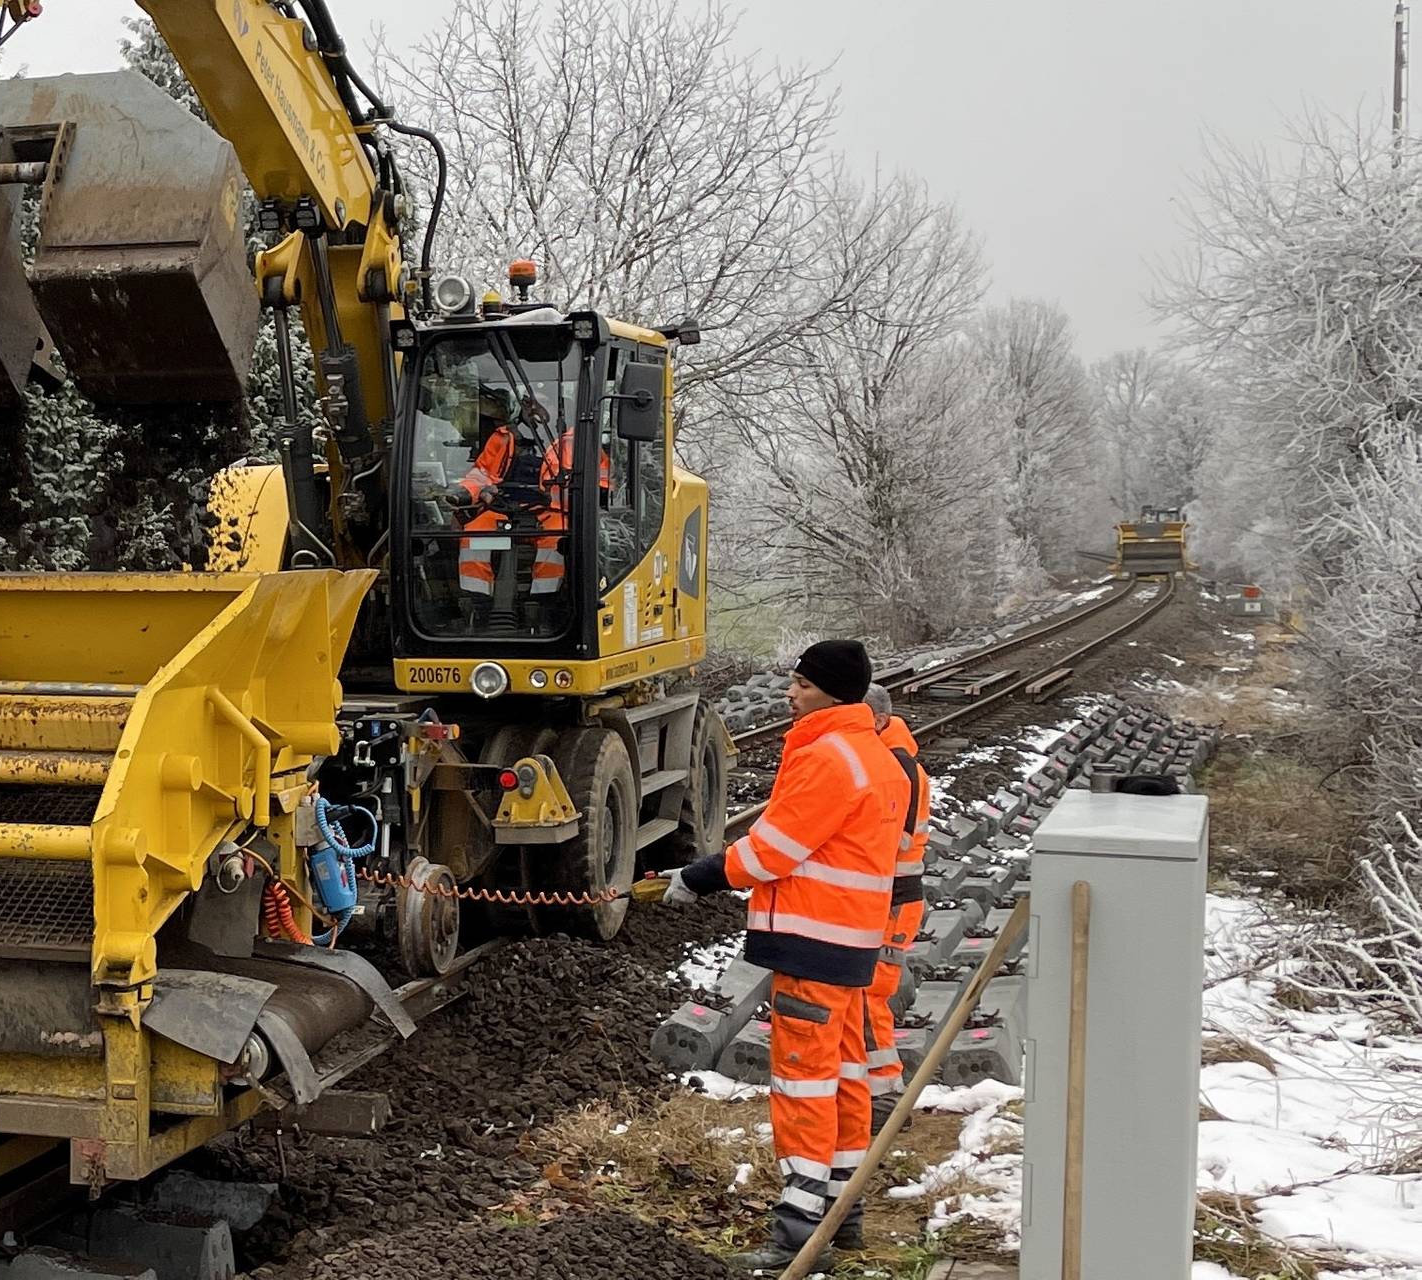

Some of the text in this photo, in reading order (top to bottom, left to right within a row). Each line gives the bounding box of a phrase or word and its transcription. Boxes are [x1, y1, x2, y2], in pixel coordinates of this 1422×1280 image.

[255, 40, 275, 87] Peter
[310, 140, 316, 163] &
[316, 152, 327, 185] Co.
[409, 667, 461, 683] 200676
